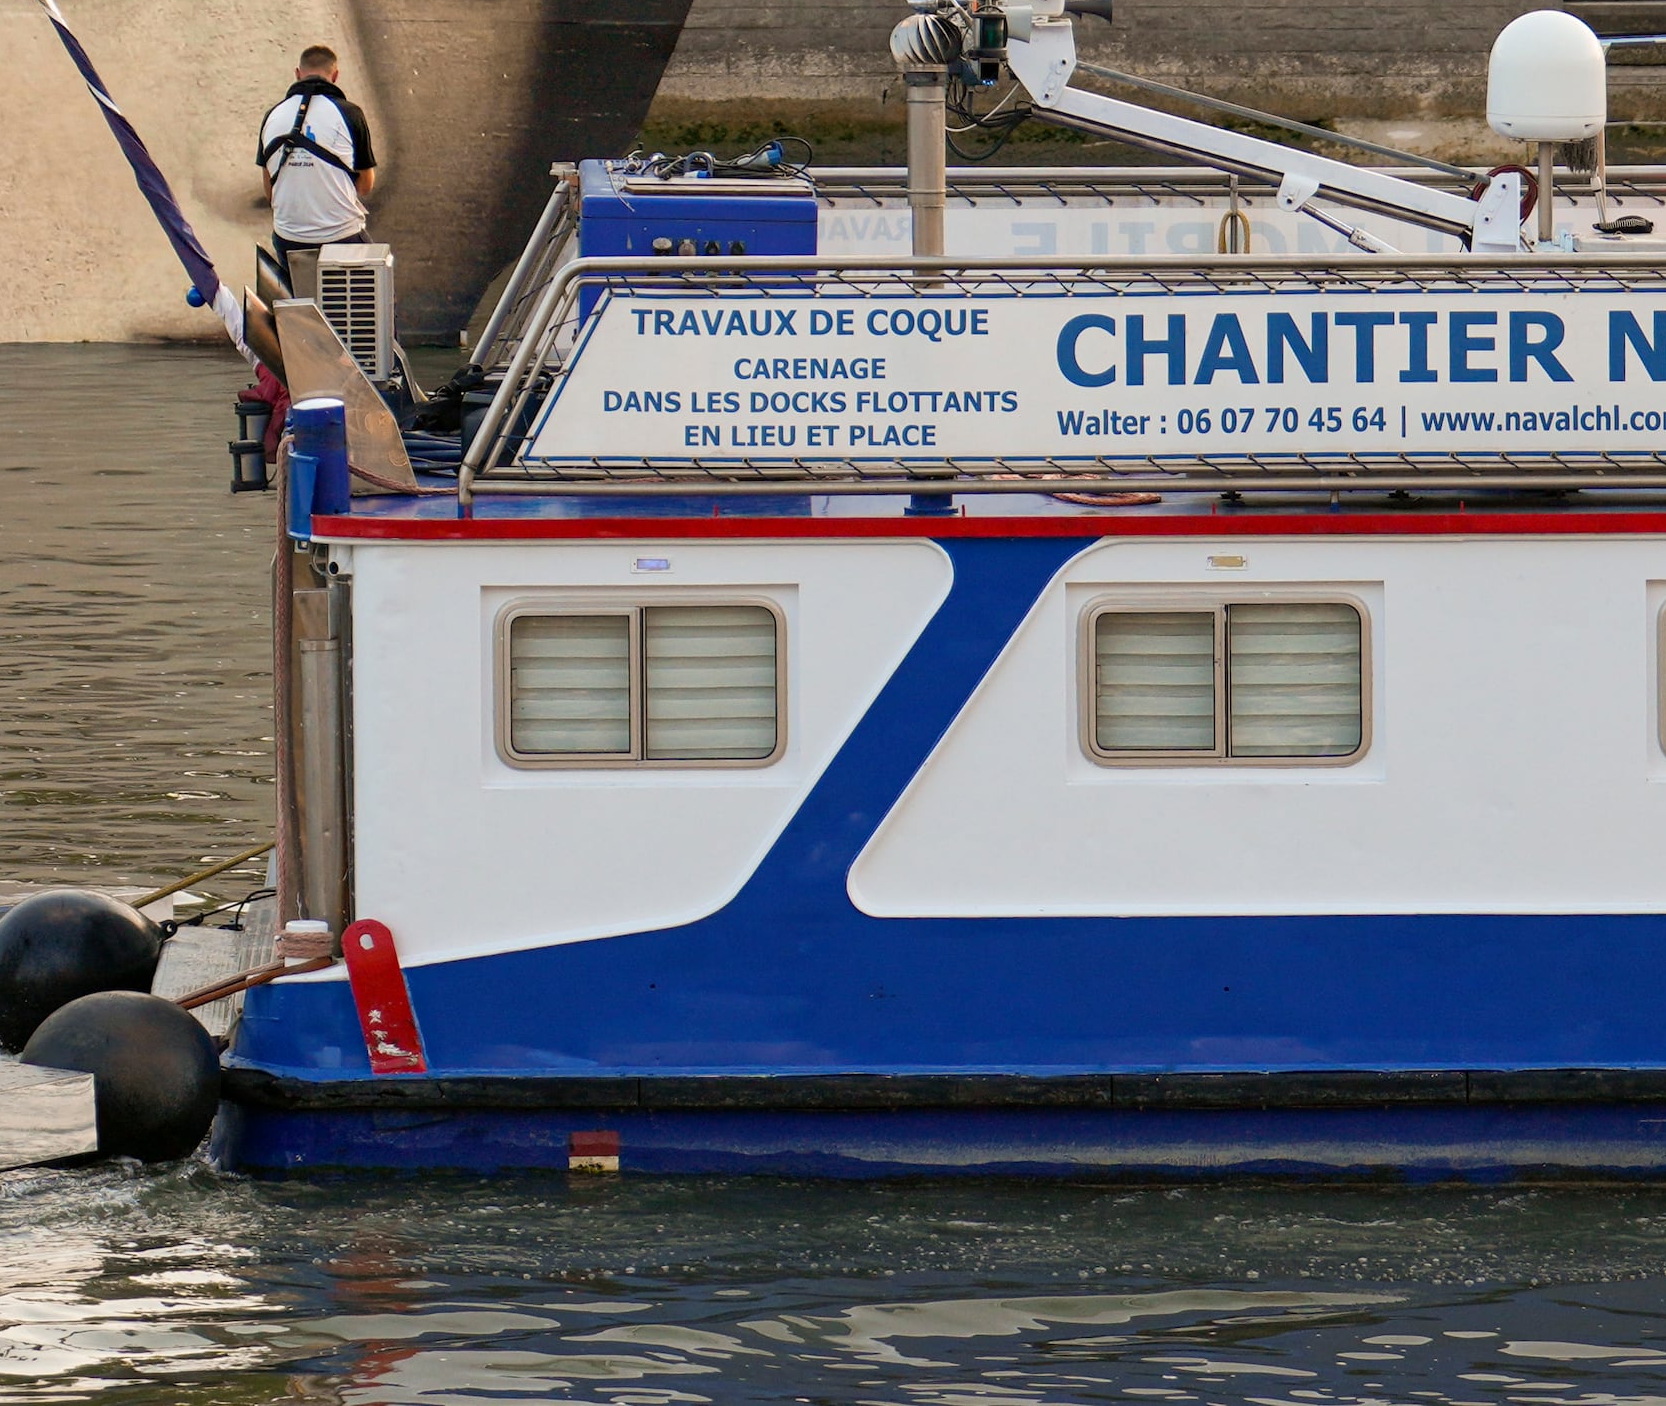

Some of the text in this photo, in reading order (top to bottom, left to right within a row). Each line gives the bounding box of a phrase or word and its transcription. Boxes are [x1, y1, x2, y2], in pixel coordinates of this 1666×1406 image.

[631, 308, 989, 342] TRAVAUX DE COQUE
[1056, 310, 1574, 387] CHANTIER
[733, 357, 886, 380] CARENAGE
[603, 390, 1018, 414] DANS LES DOCKS FLOTTANTS
[1057, 409, 1151, 436] Walter
[1160, 415, 1167, 435] :
[1177, 408, 1212, 435] 06
[1221, 408, 1255, 434] 07
[1265, 407, 1299, 433] 70
[1308, 407, 1342, 433] 45
[1351, 406, 1386, 433] 64
[685, 424, 936, 447] EN LIEU ET PLACE
